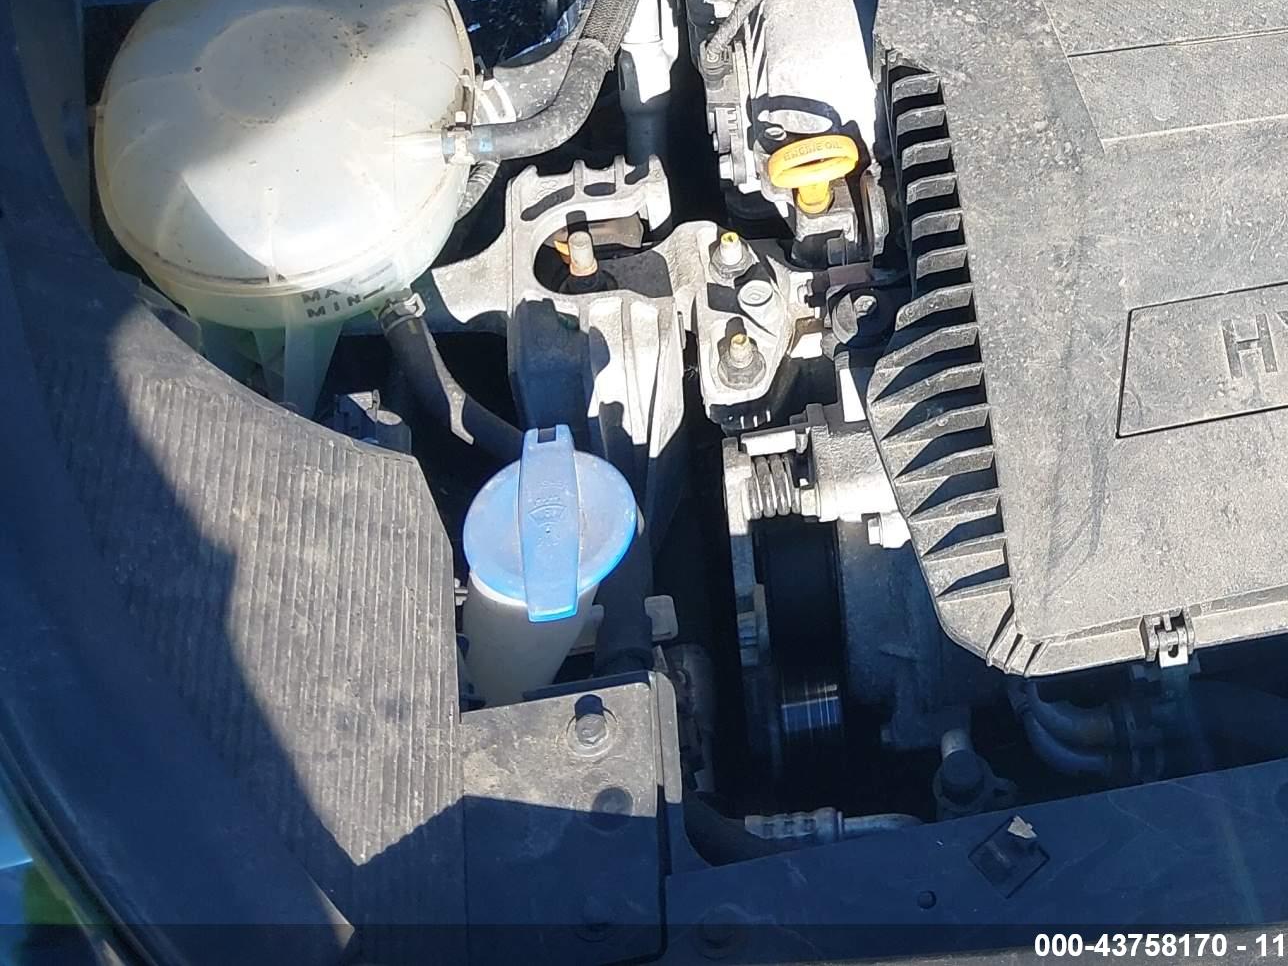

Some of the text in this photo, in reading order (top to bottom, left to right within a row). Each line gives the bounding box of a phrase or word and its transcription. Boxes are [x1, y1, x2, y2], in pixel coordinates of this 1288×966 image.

[783, 140, 844, 162] ENGINE OIL
[306, 294, 361, 318] MIN
